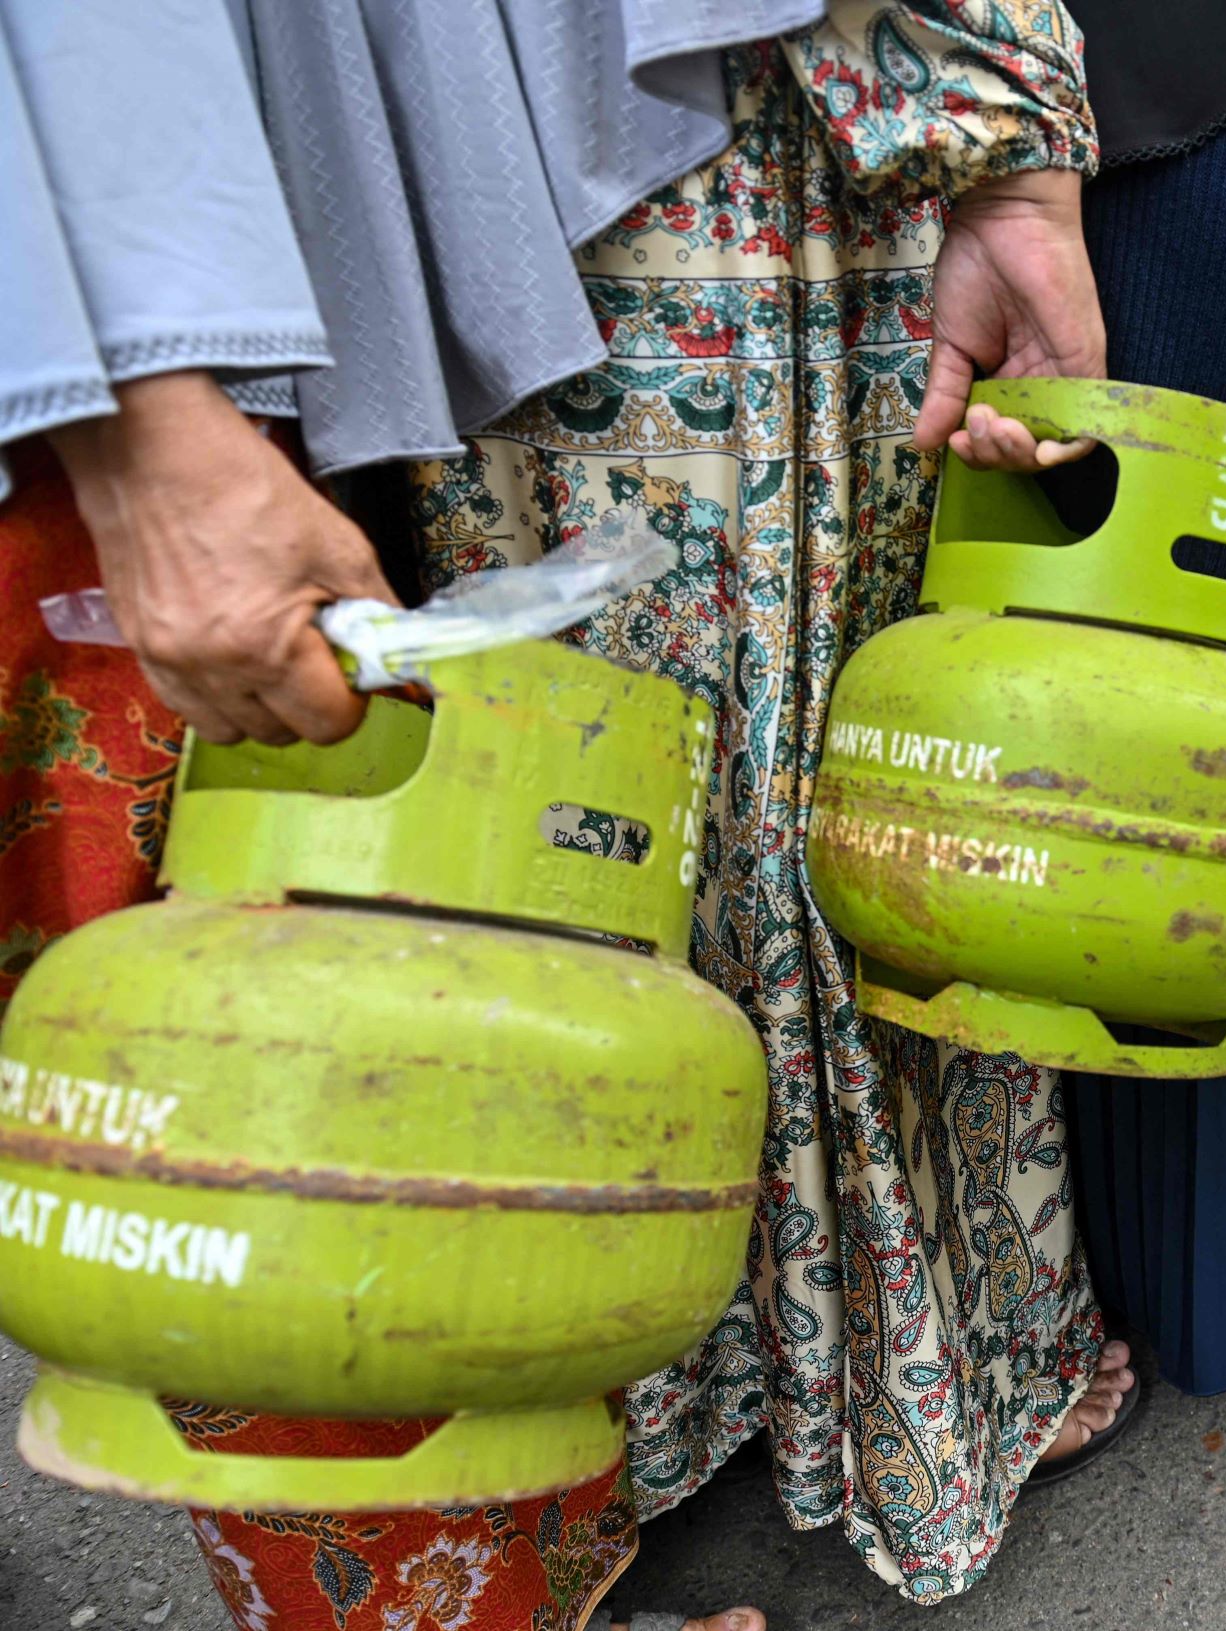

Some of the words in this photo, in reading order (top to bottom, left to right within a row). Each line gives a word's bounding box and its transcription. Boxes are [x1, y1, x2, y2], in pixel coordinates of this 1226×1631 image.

[890, 731, 1003, 784] UNTUK
[925, 831, 1050, 887] MISKIN
[28, 1069, 181, 1148] UNTUK
[61, 1200, 250, 1288] MISKIN
